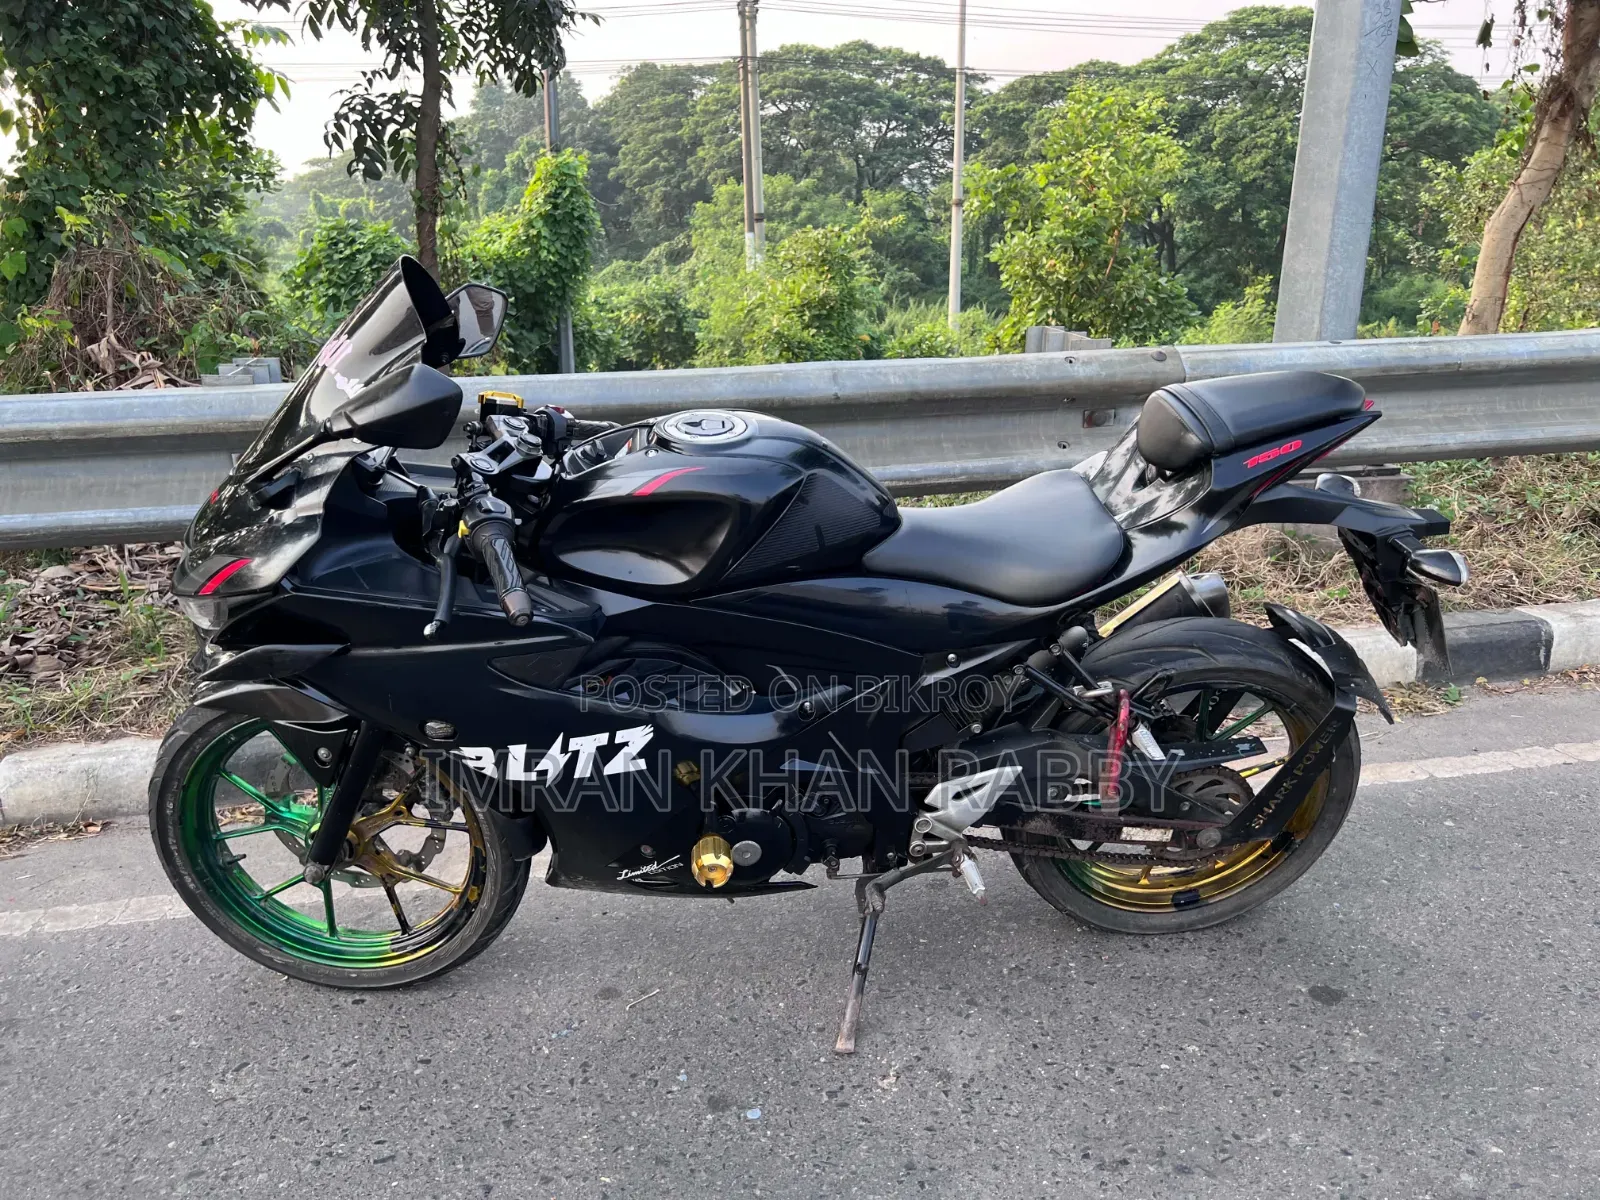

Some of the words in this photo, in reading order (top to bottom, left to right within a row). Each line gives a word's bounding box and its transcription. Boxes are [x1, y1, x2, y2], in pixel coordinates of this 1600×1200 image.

[1243, 439, 1303, 469] 150
[1251, 776, 1298, 829] SHARK
[1293, 720, 1342, 775] POWER
[616, 855, 680, 881] Limited
